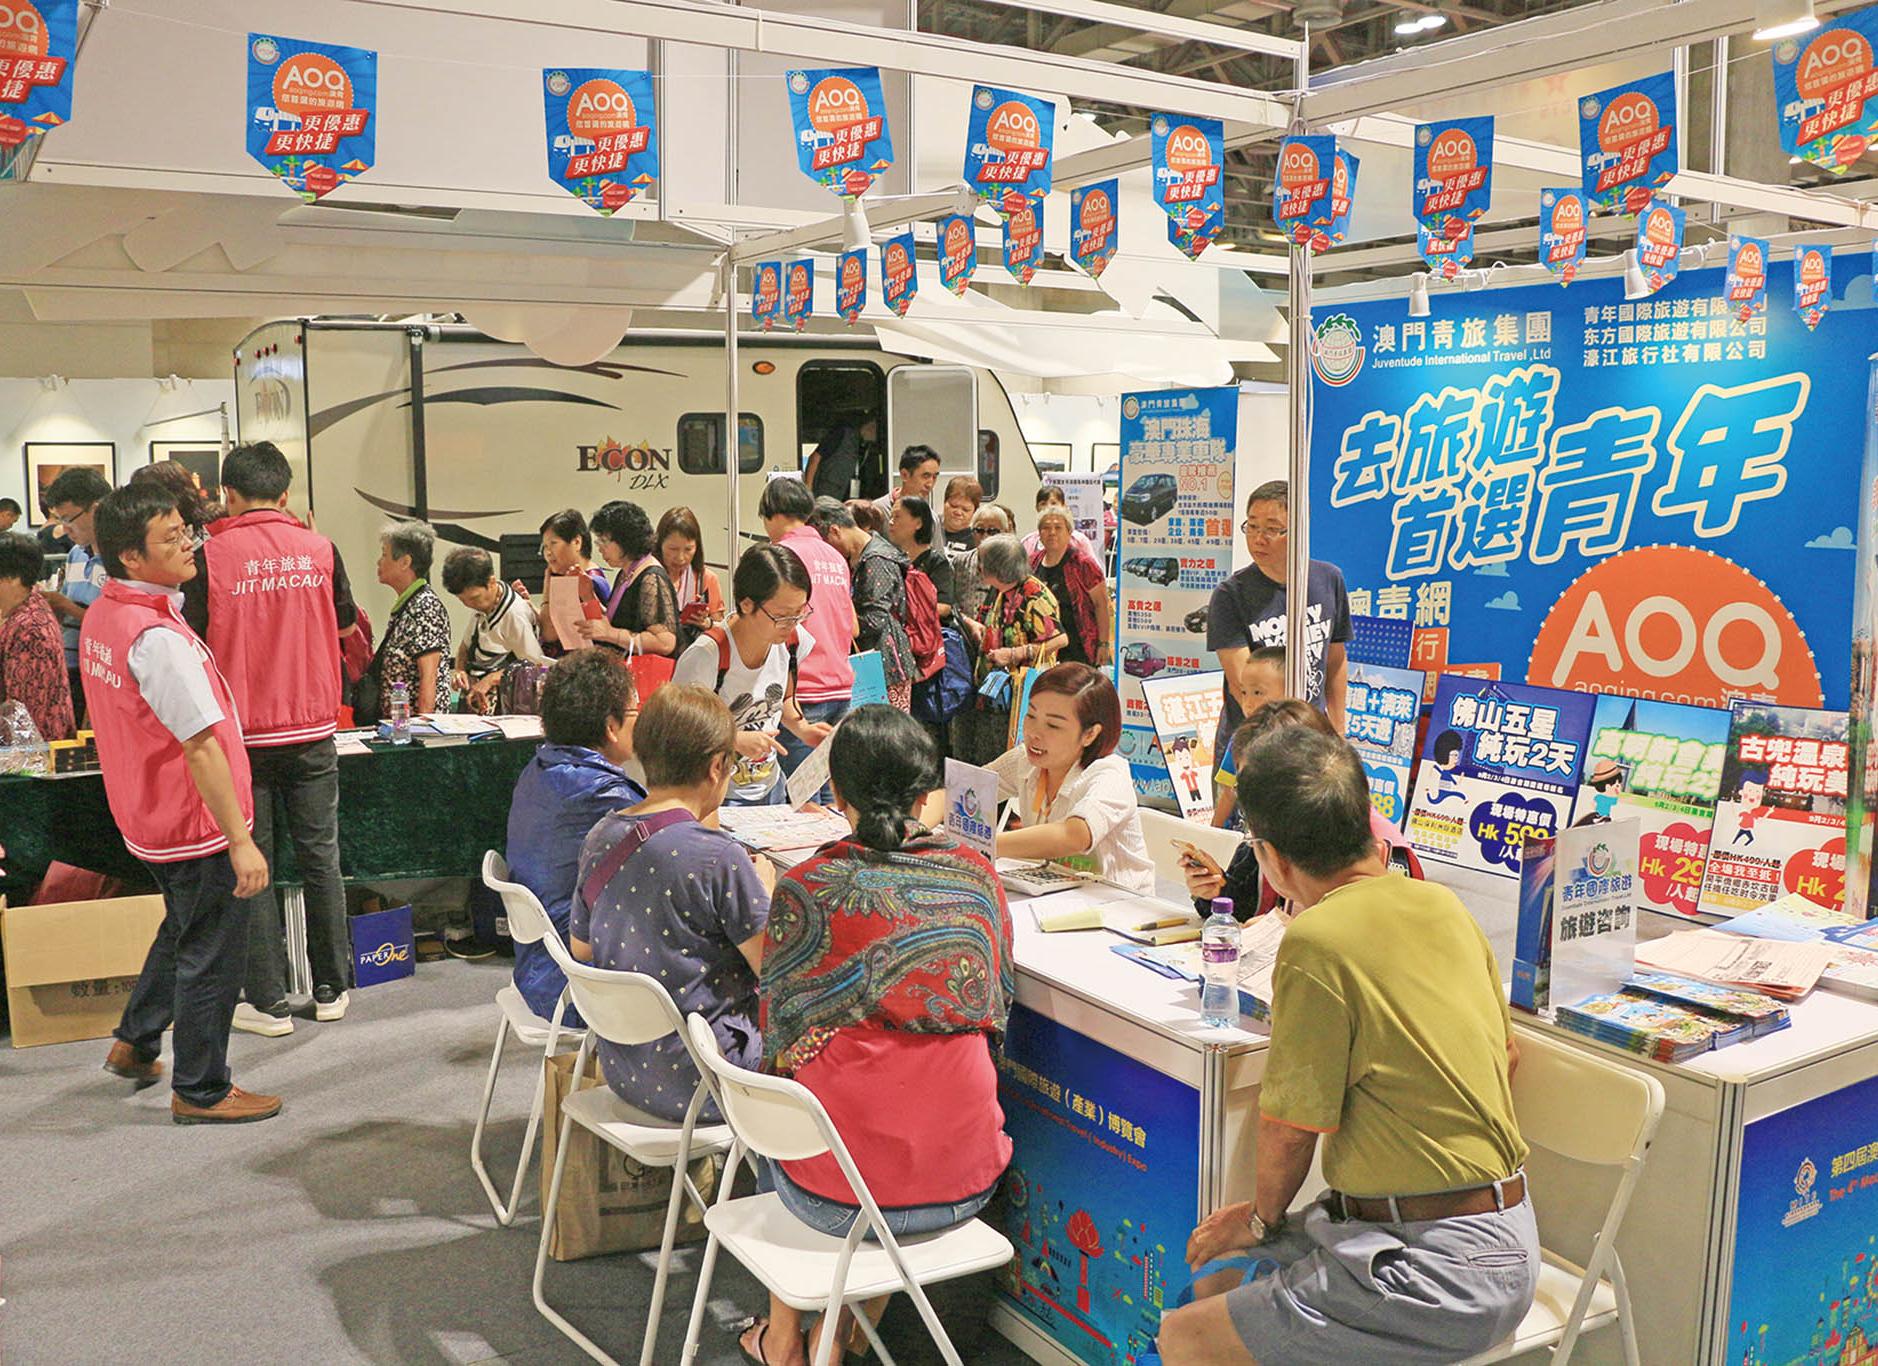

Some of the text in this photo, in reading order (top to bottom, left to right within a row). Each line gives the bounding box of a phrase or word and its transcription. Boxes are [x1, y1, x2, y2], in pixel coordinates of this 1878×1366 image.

[1805, 38, 1863, 79] AOQ
[282, 65, 344, 91] AOQ
[577, 92, 628, 117] AOQ
[815, 89, 860, 112] AOQ
[303, 113, 362, 132] 更優惠
[994, 111, 1035, 131] AOQ
[1605, 101, 1650, 134] AOQ
[1804, 100, 1858, 141] 更快捷
[275, 132, 335, 152] 更快捷
[597, 130, 644, 152] 更優惠
[835, 121, 878, 145] 更優惠
[1174, 135, 1206, 152] AOQ
[818, 141, 860, 167] 更快捷
[1006, 150, 1045, 168] 更優惠
[1285, 152, 1313, 170] AOQ
[1433, 140, 1470, 163] AOQ
[1622, 133, 1668, 166] 更優惠
[573, 151, 625, 173] 更快捷
[982, 164, 1028, 181] 更快捷
[1602, 151, 1649, 188] 更快捷
[1184, 168, 1216, 187] 更優惠
[1444, 170, 1484, 191] 更優惠
[1169, 183, 1207, 200] 更快捷
[1426, 188, 1464, 213] 更快捷
[1583, 293, 1767, 325] 青年國際旅遊有限
[1372, 312, 1552, 354] 澳門青旅集團
[1372, 356, 1423, 369] Juventude
[1425, 351, 1491, 367] International
[1493, 349, 1527, 361] Travel
[576, 445, 673, 472] ECON
[629, 473, 670, 490] DLX
[244, 554, 313, 577] 青年旅遊
[231, 573, 324, 597] JIT MACAU
[1551, 590, 1782, 691] AOQ
[1451, 696, 1558, 741] 佛山五星
[1474, 730, 1578, 775] 純玩2天
[1478, 822, 1499, 841] Hk
[1641, 857, 1666, 877] Hk
[1797, 875, 1827, 898] Hk
